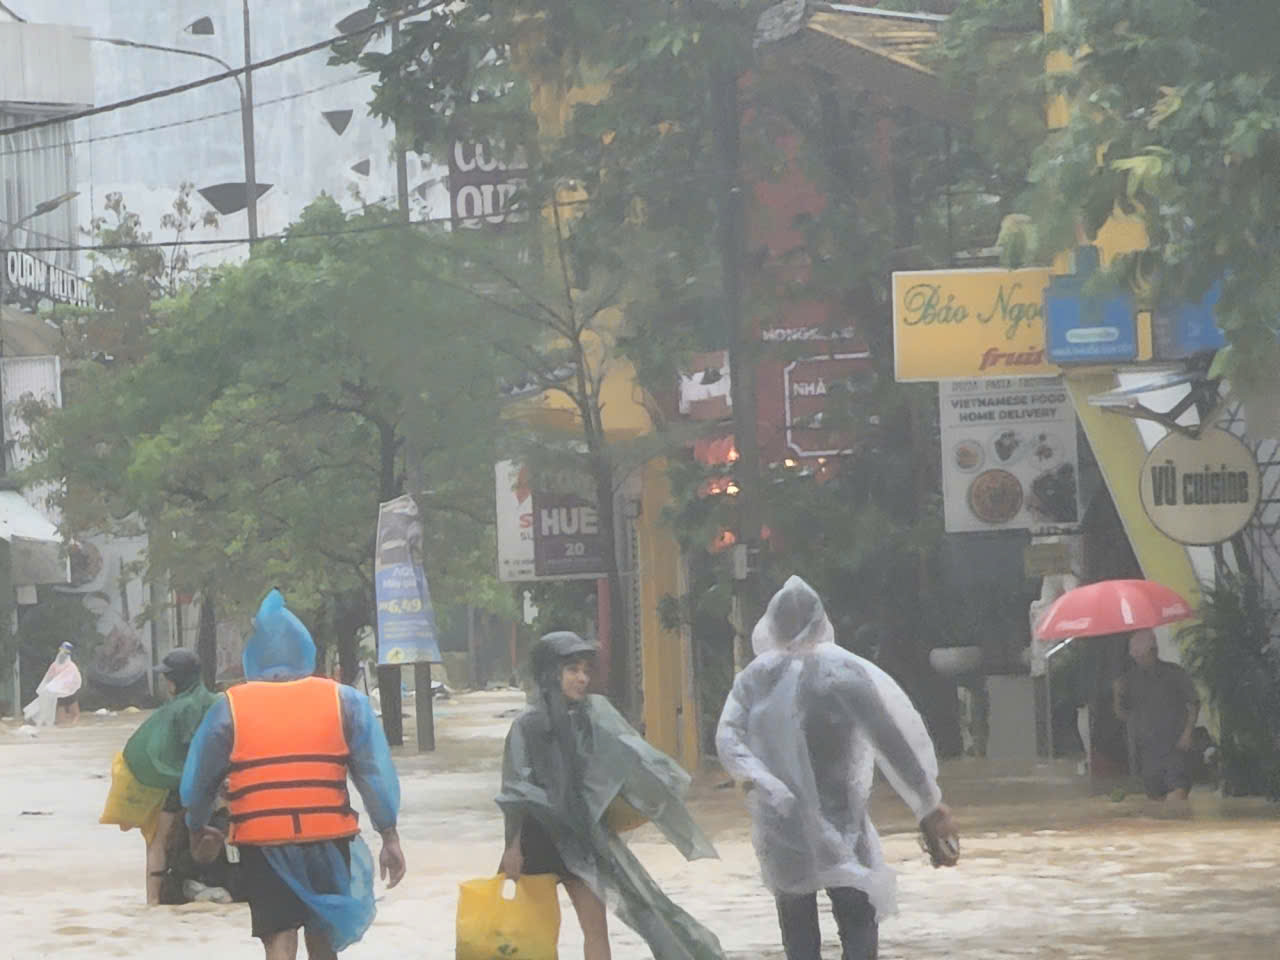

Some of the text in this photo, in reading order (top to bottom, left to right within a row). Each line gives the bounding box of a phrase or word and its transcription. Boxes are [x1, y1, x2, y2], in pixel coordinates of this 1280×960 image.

[951, 393, 1066, 409] VIETNAMESE FOOD
[959, 407, 1057, 423] HOME DELIVERY
[1182, 463, 1249, 505] cuisine
[565, 543, 585, 556] 20
